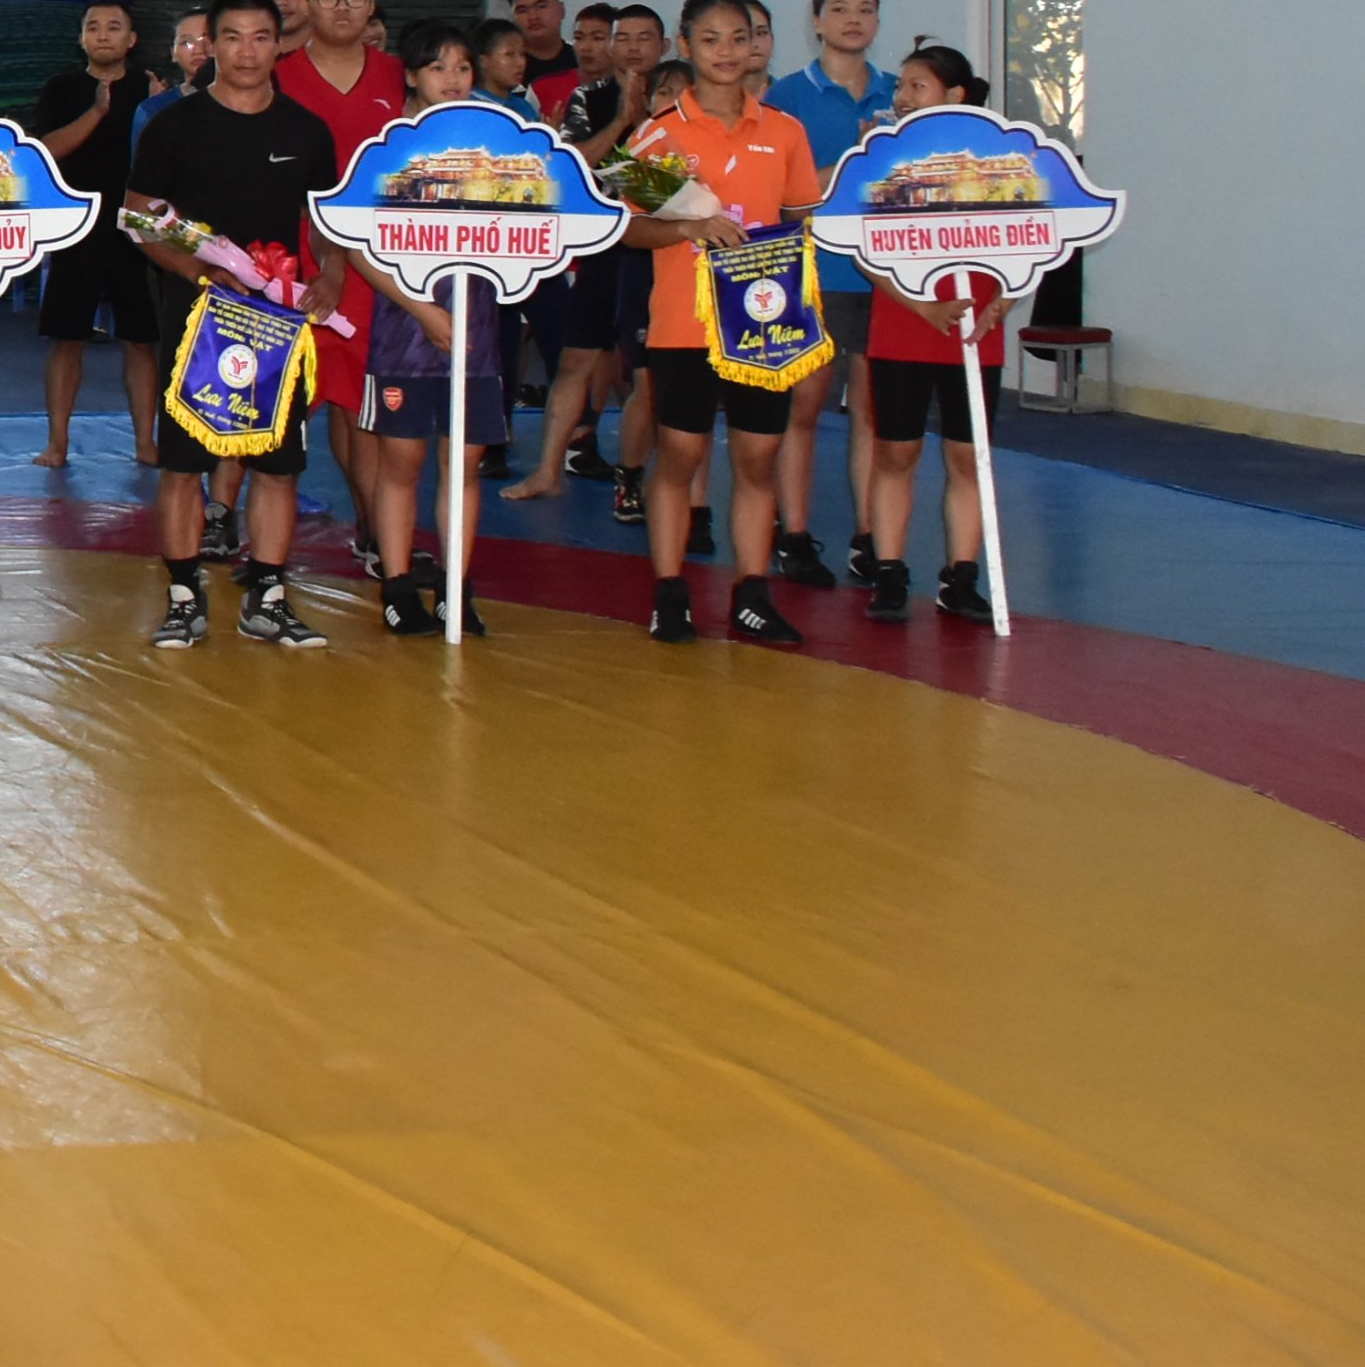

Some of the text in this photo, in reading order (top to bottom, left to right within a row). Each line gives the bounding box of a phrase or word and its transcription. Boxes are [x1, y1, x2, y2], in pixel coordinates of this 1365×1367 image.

[377, 217, 554, 255] THÀNH PHỐ HUẾ
[871, 224, 932, 256] HUYỆN
[938, 219, 1001, 251] QUẢNG
